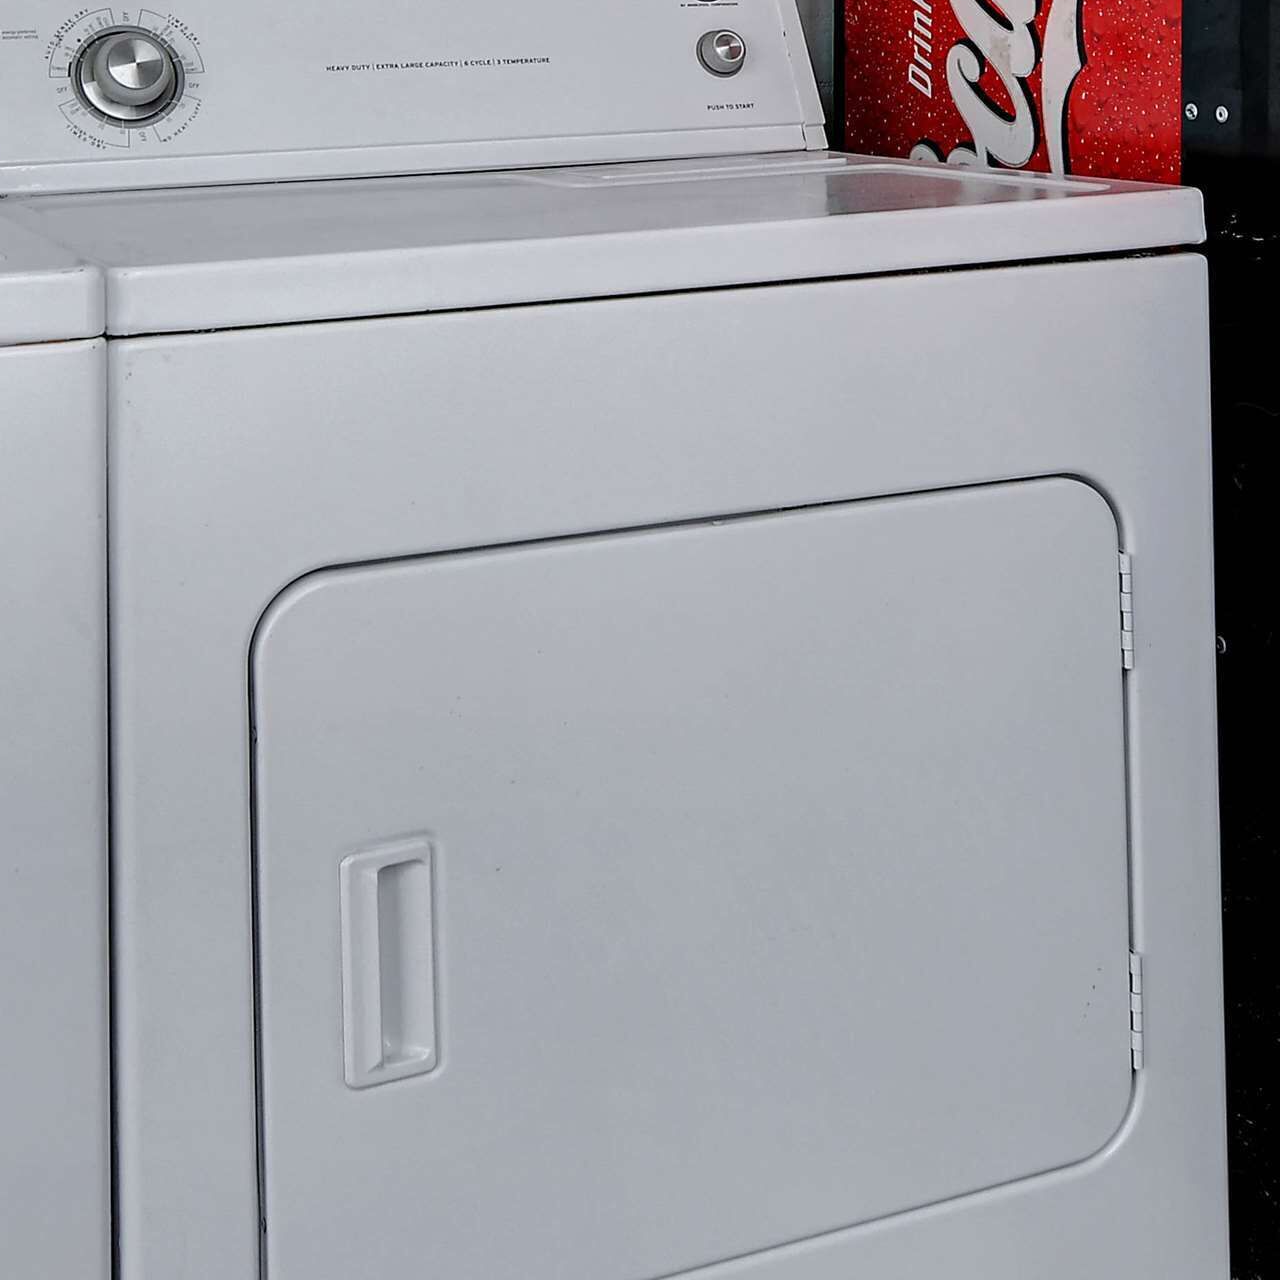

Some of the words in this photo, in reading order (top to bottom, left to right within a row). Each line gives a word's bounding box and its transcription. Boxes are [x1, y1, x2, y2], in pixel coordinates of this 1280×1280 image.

[425, 60, 458, 68] CAPACITY
[470, 59, 491, 67] CYCLE
[502, 57, 550, 65] TEMPERATURE
